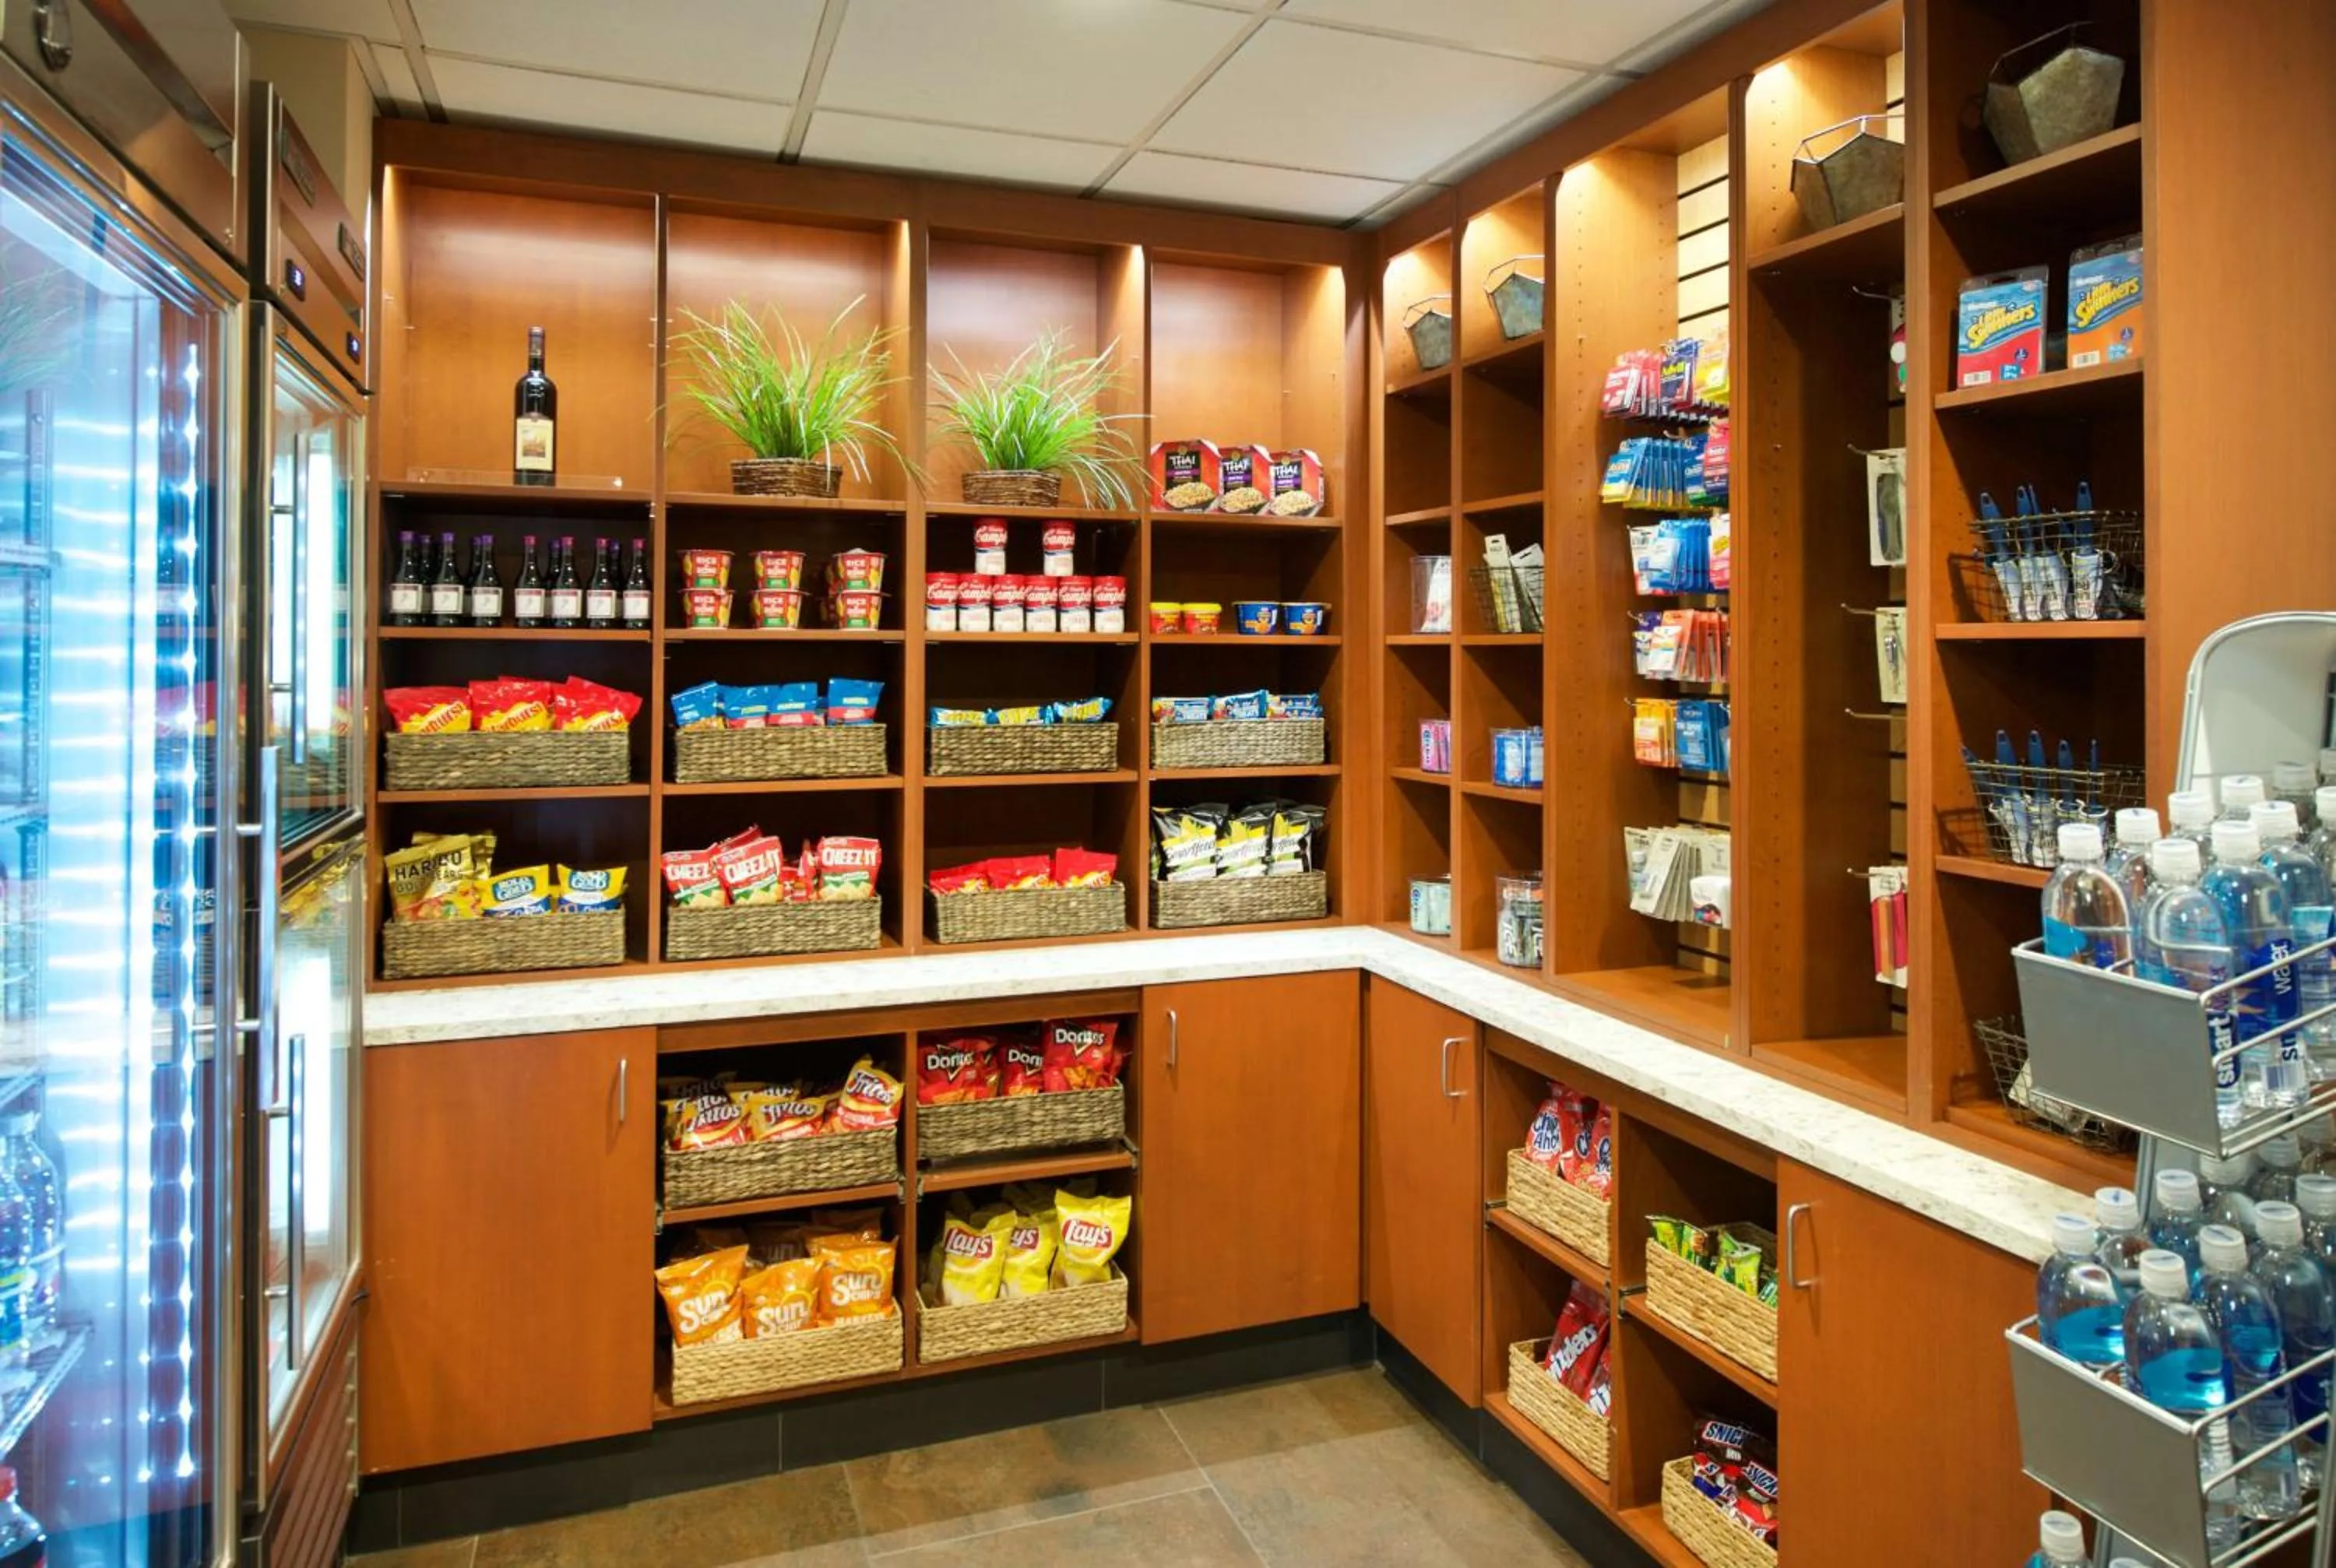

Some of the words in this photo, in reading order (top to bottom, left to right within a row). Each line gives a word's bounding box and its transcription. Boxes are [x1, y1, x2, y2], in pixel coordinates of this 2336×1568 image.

[1170, 455, 1196, 466] THAI
[1225, 461, 1251, 472] THAI
[1275, 466, 1298, 476] THAI
[2270, 943, 2293, 995] waer
[1055, 1028, 1104, 1046] Doritos
[846, 1071, 892, 1104] Fritos
[831, 1272, 881, 1306] Sun
[677, 1289, 727, 1334] Sun
[756, 1301, 807, 1338] Sun
